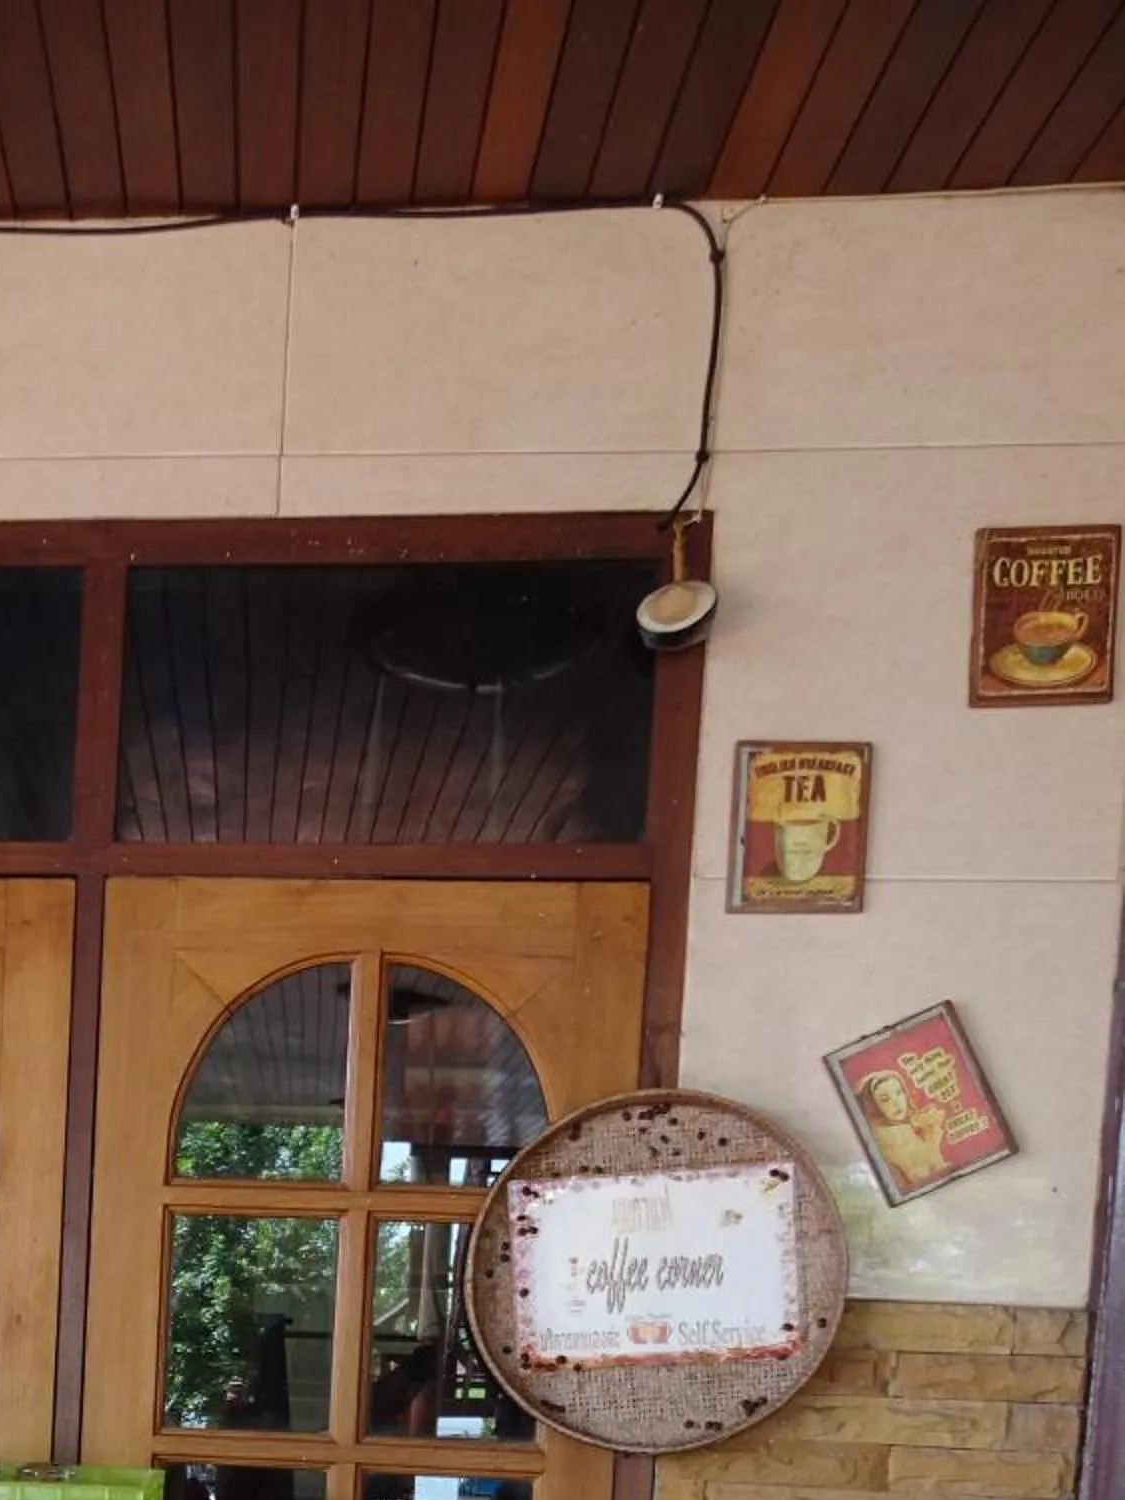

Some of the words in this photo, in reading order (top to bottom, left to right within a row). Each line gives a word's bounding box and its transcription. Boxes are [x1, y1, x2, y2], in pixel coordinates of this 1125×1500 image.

[993, 553, 1103, 587] COFFEE
[782, 774, 827, 803] TEA
[586, 1237, 649, 1314] coffee
[656, 1253, 724, 1292] corner
[678, 1319, 709, 1346] Self
